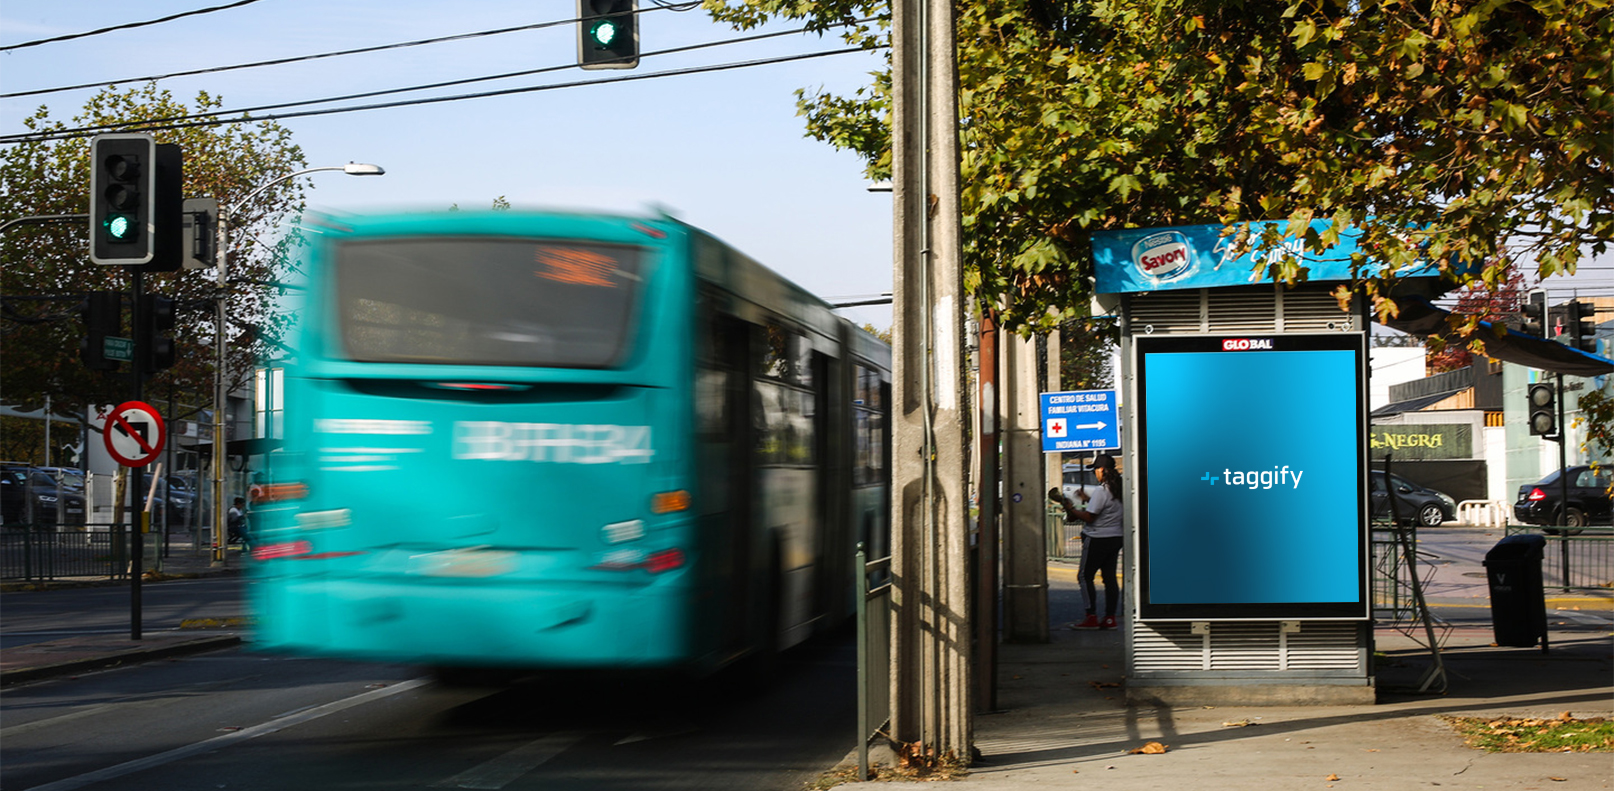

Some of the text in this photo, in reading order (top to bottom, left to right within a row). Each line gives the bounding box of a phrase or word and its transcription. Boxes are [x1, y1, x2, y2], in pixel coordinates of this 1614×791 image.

[1141, 248, 1185, 271] Savory
[1223, 339, 1273, 350] GLOBAL
[1049, 393, 1107, 404] CENTRO DE SALUD
[1048, 403, 1109, 415] FAMILIAR VITACURA
[1056, 440, 1082, 449] INDIANA
[1091, 439, 1106, 448] 1195
[1382, 432, 1443, 450] NEGRA
[1223, 465, 1304, 490] taggify
